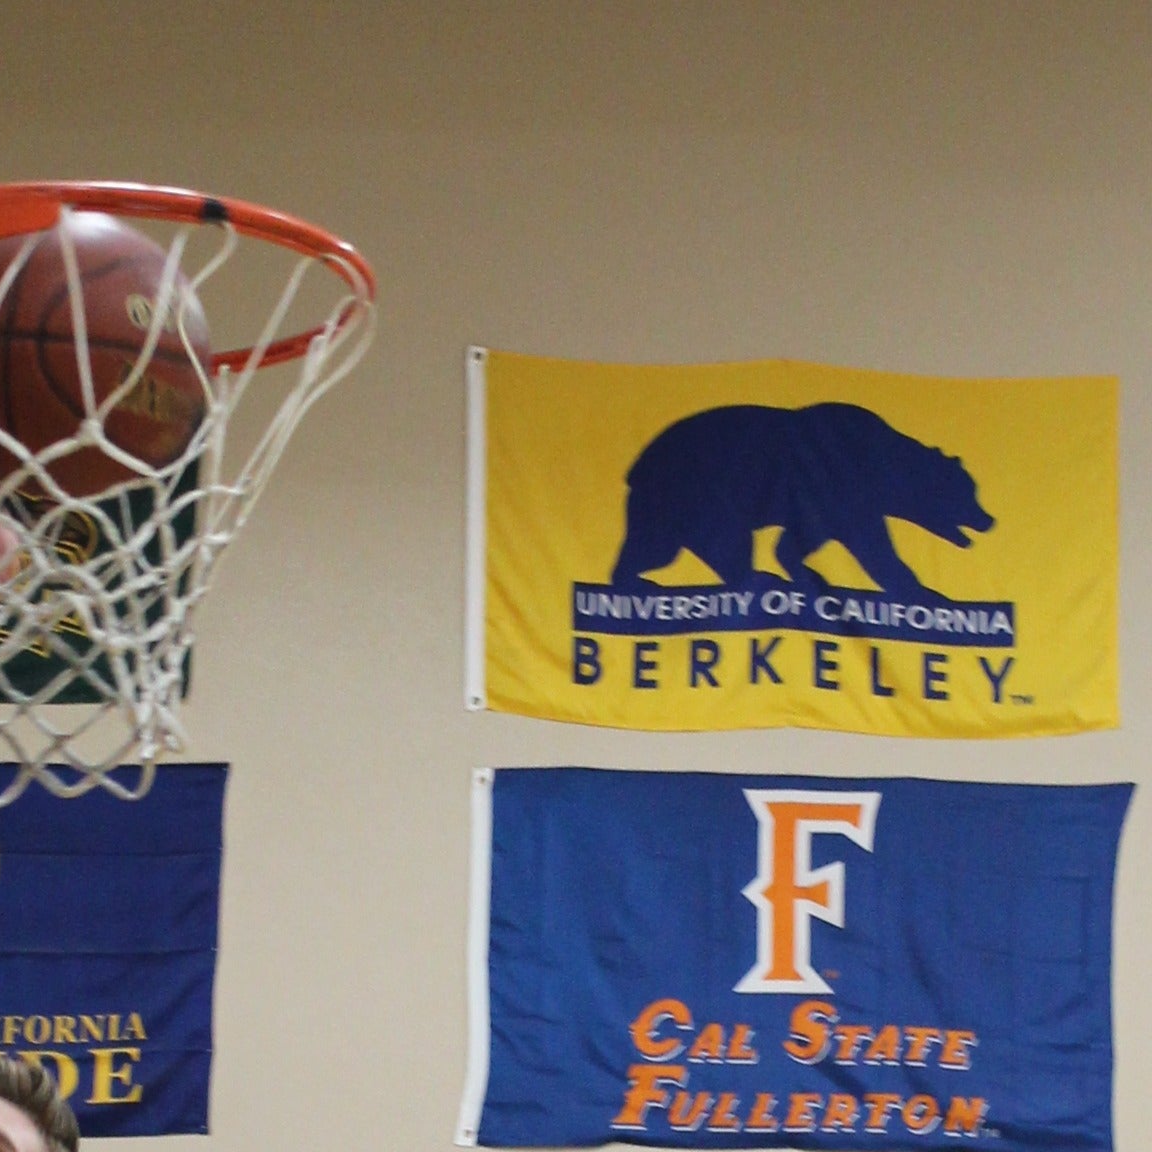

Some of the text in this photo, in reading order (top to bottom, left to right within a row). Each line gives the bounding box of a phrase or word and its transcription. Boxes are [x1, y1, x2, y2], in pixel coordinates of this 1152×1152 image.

[576, 589, 1015, 635] UNIVERSITY OF CALIFORNIA
[572, 635, 1016, 704] BERKELEY
[732, 788, 882, 995] F
[628, 998, 979, 1071] CAL STATE
[609, 1063, 990, 1138] FULLERTON
